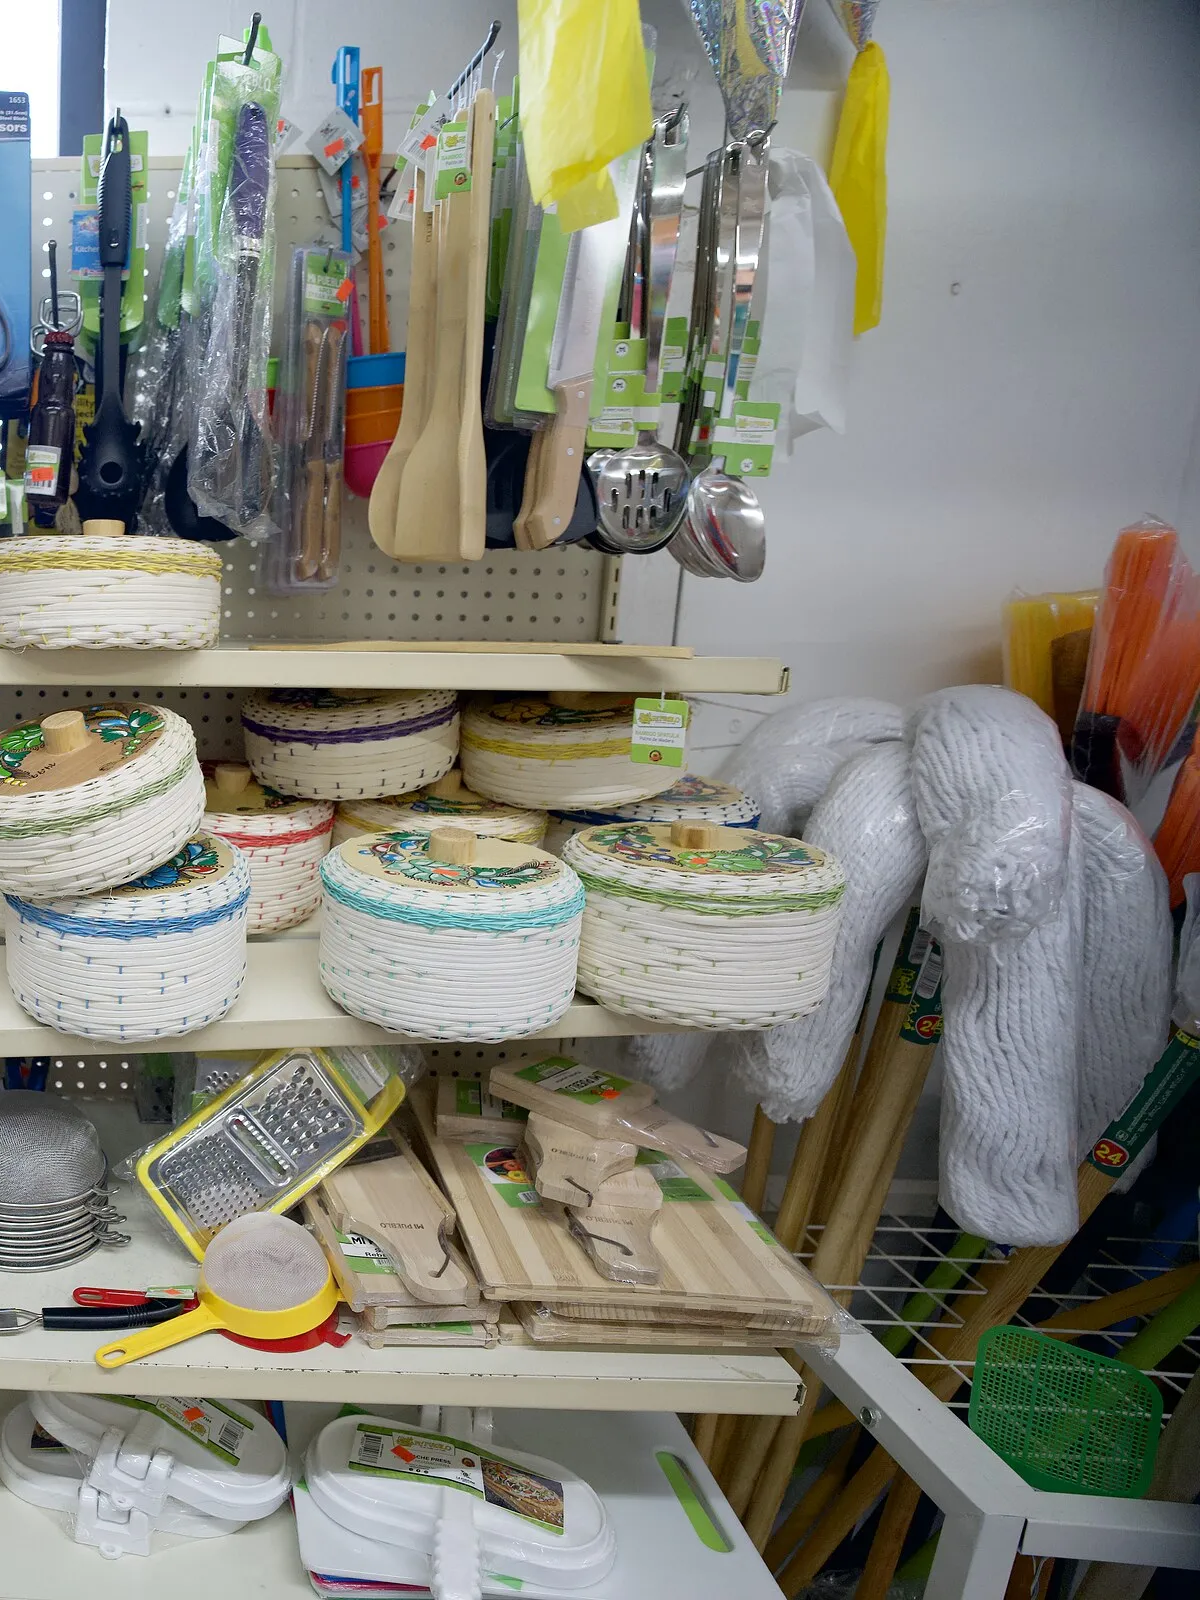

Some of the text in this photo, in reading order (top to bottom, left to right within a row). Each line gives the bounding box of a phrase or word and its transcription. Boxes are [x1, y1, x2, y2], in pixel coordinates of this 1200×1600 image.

[9, 96, 26, 105] 1653
[1095, 1143, 1124, 1166] 24
[379, 1221, 425, 1231] MI PUEBLO
[351, 1236, 366, 1245] MI
[431, 1456, 452, 1465] PRESS
